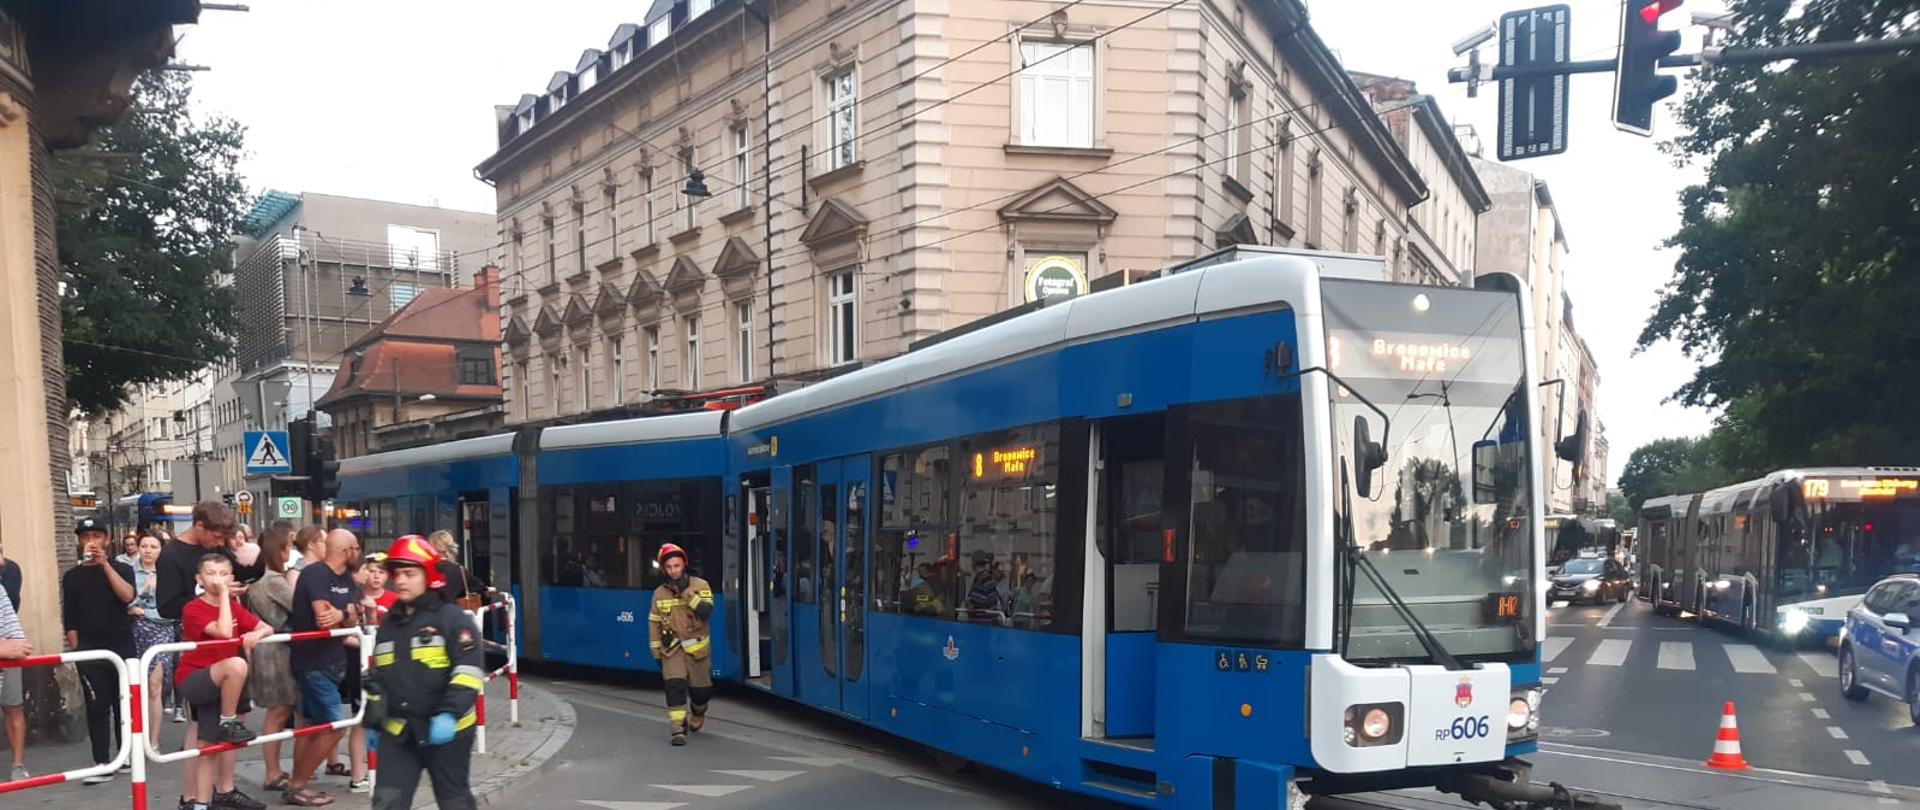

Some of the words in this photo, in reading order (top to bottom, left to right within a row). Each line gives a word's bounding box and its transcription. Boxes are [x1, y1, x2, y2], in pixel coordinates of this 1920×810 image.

[976, 453, 983, 477] 8
[993, 447, 1035, 463] Bronowice
[1804, 480, 1829, 497] 179
